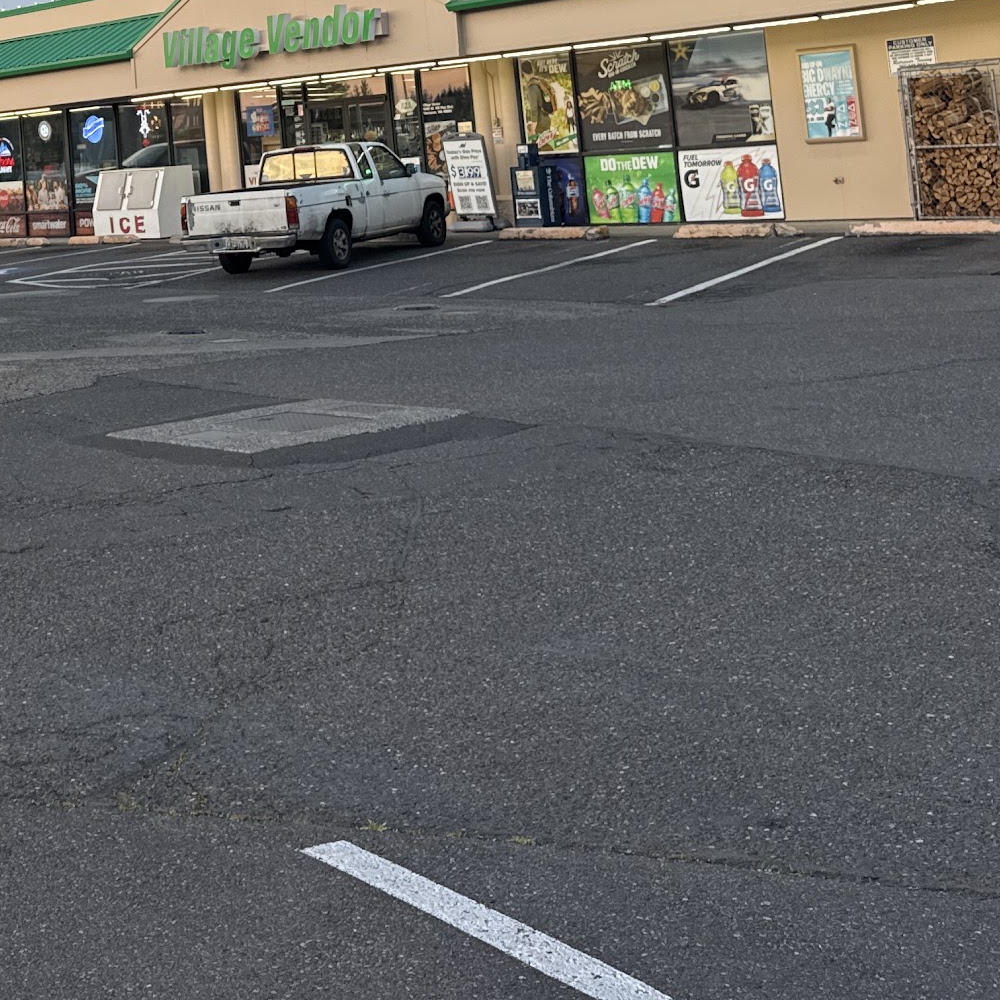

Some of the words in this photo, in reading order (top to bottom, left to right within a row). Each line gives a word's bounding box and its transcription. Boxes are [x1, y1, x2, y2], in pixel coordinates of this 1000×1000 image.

[163, 26, 257, 69] Village
[267, 4, 382, 54] Vendor
[893, 37, 927, 45] CUSTOMER
[597, 49, 640, 79] Scratch
[609, 79, 632, 91] ATM
[592, 132, 607, 141] EVERY
[608, 131, 623, 140] BATCH
[624, 130, 638, 139] FROM
[639, 128, 662, 138] SCRATCH
[600, 158, 616, 172] DO
[616, 161, 632, 171] THE
[632, 155, 659, 170] DEW
[684, 159, 723, 168] TOMORROW
[248, 177, 257, 186] VI
[684, 169, 700, 188] G
[763, 178, 773, 191] G
[726, 181, 736, 192] G
[743, 178, 755, 192] G
[193, 204, 221, 212] NISSAN
[32, 218, 67, 230] smartwater
[79, 218, 94, 228] POW
[109, 216, 146, 234] ICE
